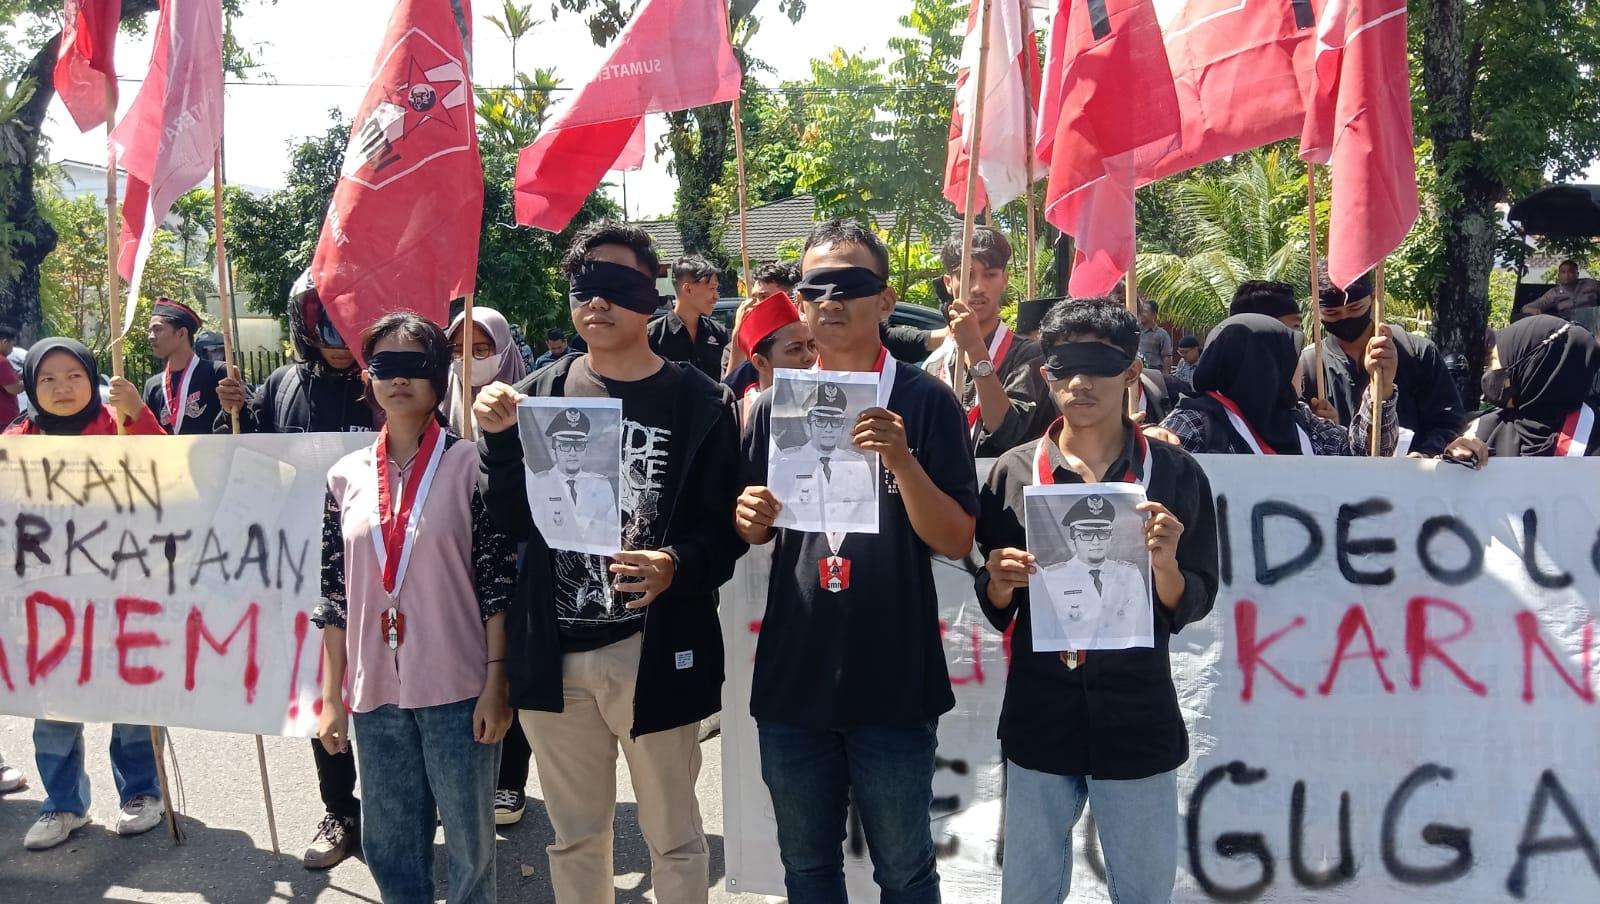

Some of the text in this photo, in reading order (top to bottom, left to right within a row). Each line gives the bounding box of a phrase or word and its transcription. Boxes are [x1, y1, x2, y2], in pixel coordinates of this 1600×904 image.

[0, 448, 163, 522] IKAN
[0, 512, 310, 594] RKATAAN
[1216, 494, 1600, 588] IDEOL
